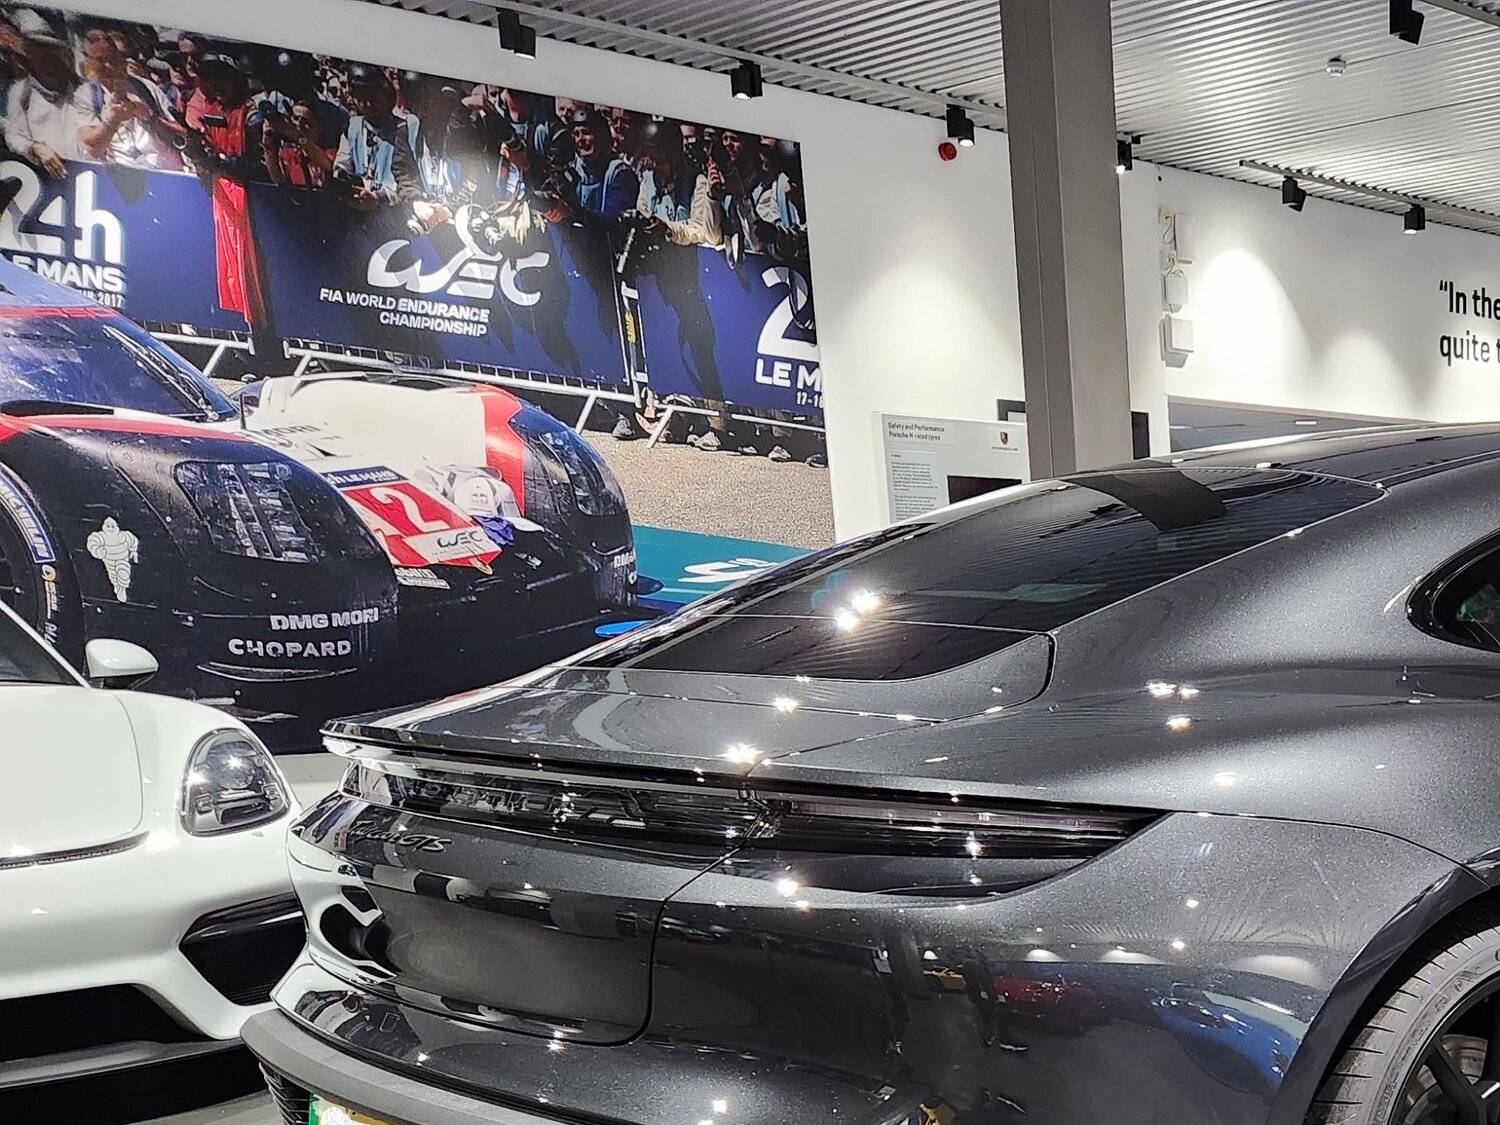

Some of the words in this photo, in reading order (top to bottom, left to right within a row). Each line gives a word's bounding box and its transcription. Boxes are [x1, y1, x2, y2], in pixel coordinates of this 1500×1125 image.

[367, 203, 550, 307] WEC
[36, 257, 125, 293] MANS
[319, 288, 343, 304] FIA
[346, 291, 396, 310] WORLD
[397, 298, 491, 323] ENDURANCE
[379, 311, 487, 337] CHAMPIONSHIP
[1440, 330, 1490, 366] quite
[755, 358, 792, 387] LE
[269, 613, 329, 631] DMG
[331, 607, 379, 627] MORI
[228, 638, 352, 658] CHOPARD
[400, 834, 452, 852] GTS
